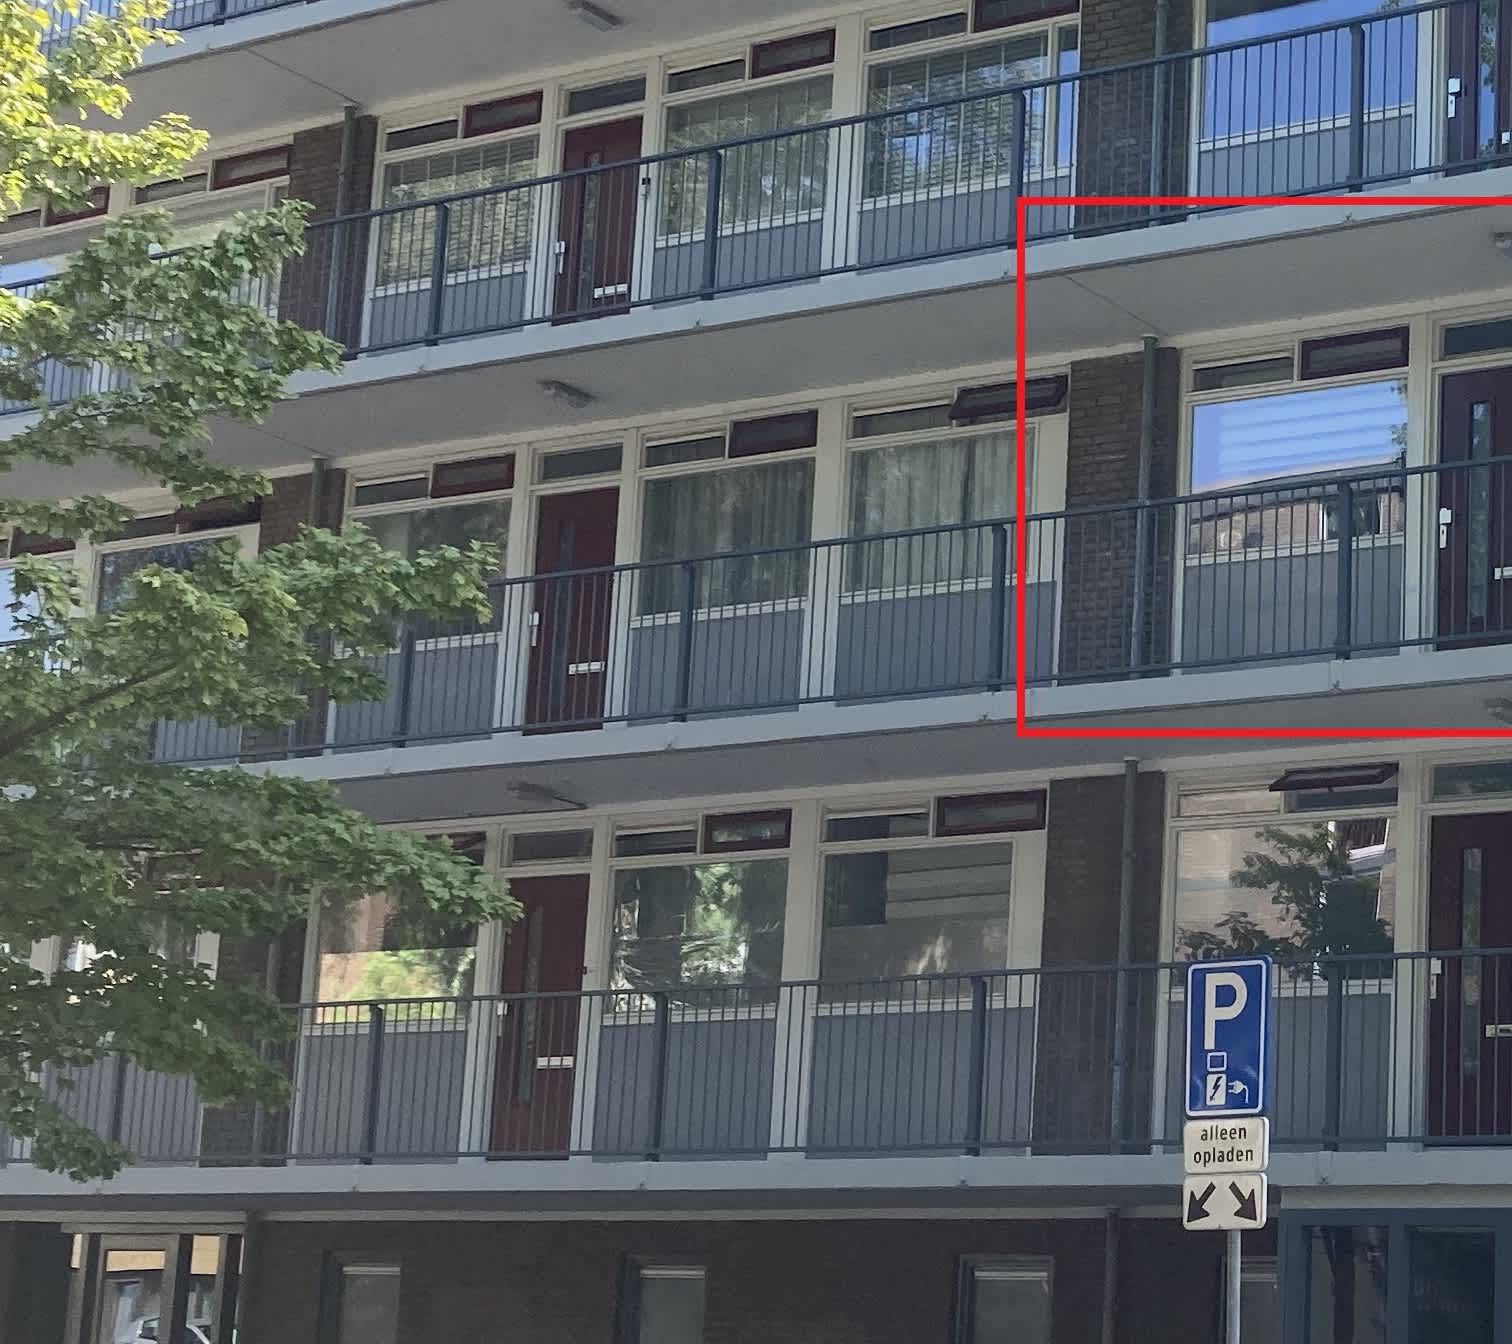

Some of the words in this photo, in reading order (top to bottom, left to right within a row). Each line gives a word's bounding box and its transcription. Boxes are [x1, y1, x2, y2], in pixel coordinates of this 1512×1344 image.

[1204, 972, 1248, 1050] P
[1200, 1124, 1247, 1141] alleen
[1193, 1146, 1254, 1168] opladen
